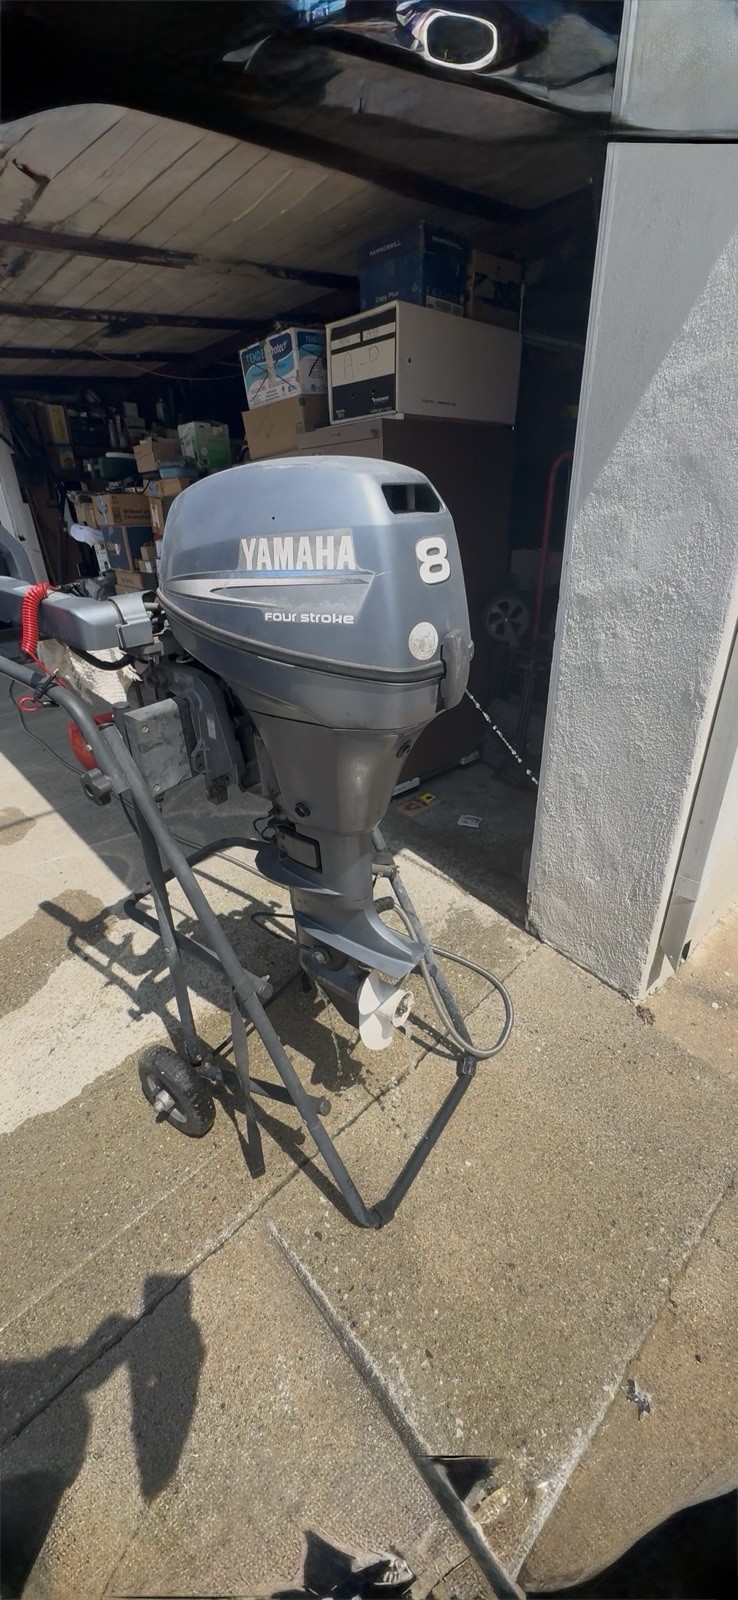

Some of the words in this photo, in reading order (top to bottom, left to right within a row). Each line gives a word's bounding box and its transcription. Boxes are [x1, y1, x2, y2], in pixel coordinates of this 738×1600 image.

[375, 294, 388, 303] Copy
[388, 290, 400, 299] Plus
[241, 535, 356, 571] YAMAHA
[415, 537, 450, 585] 8
